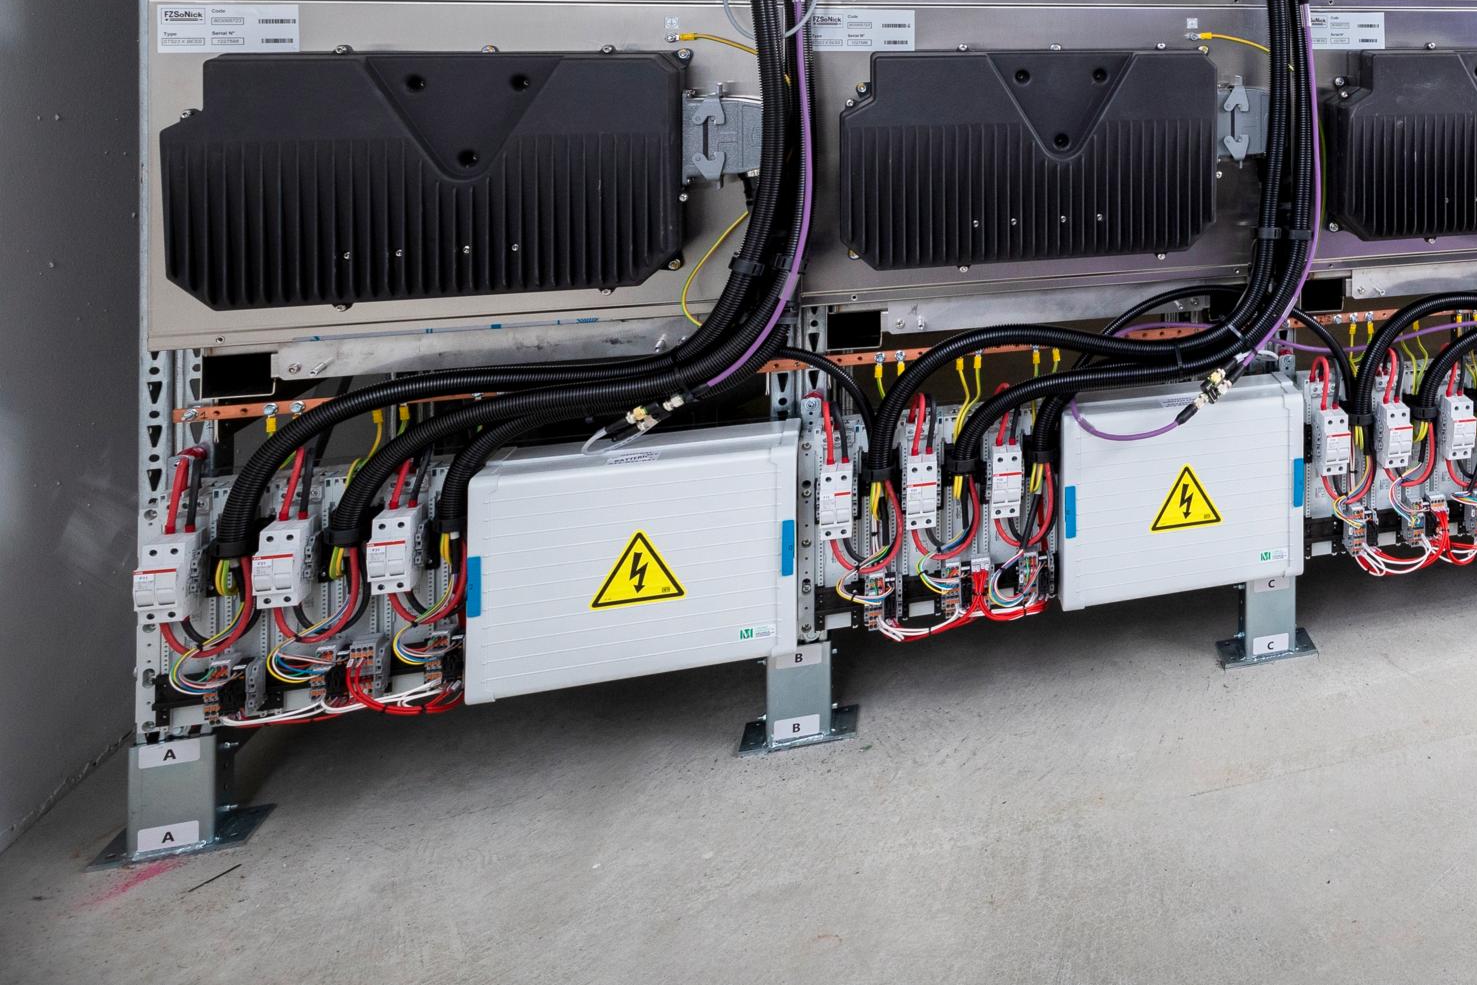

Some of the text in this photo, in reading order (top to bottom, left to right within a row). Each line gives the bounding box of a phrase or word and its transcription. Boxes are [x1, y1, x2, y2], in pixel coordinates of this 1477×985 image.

[164, 10, 203, 18] FZSoNick
[812, 15, 842, 23] FZSoNick
[1268, 579, 1275, 588] C
[1267, 641, 1274, 650] C
[794, 653, 803, 663] B
[792, 723, 801, 733] B
[163, 749, 176, 761] A
[161, 831, 175, 843] A
